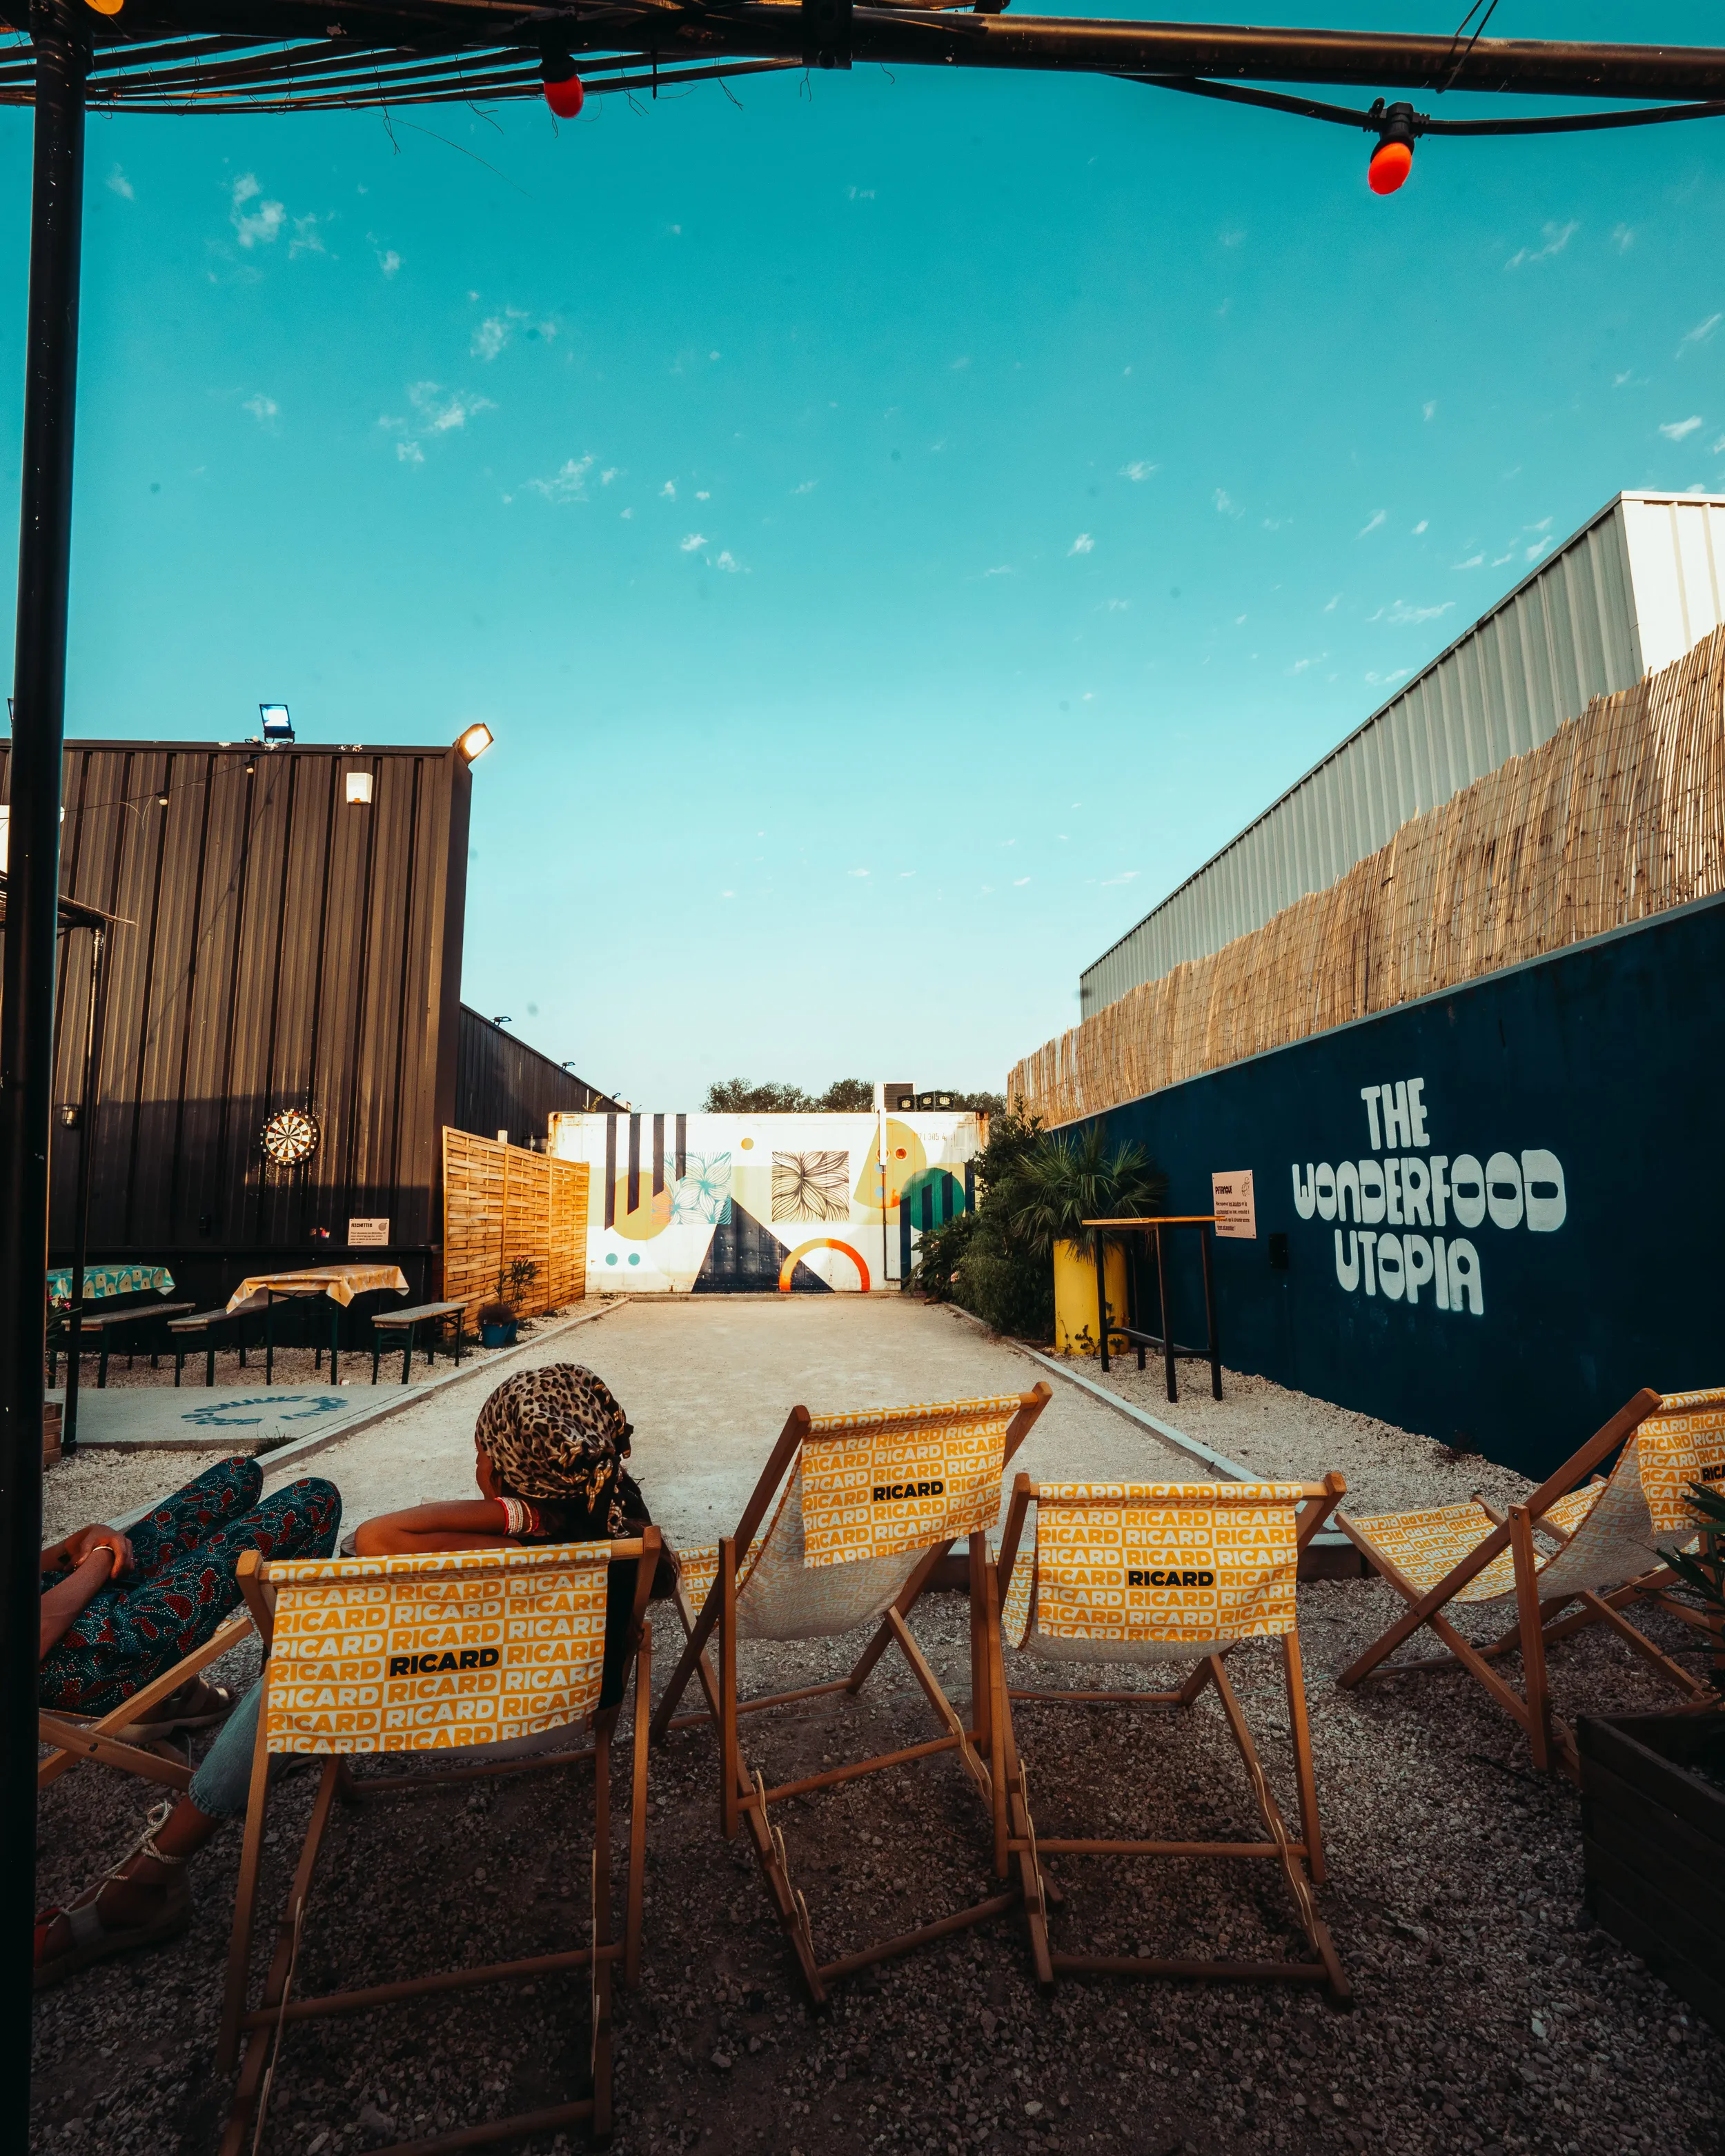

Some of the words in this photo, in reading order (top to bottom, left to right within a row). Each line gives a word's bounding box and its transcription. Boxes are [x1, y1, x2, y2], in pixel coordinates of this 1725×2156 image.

[1361, 1078, 1430, 1150] THE
[1292, 1149, 1566, 1232] WONDERFOOD
[1334, 1229, 1483, 1315] UTOPIA
[811, 1414, 883, 1432] RICARD
[888, 1407, 956, 1424] RICARD
[959, 1399, 1021, 1415] RICARD
[1657, 1395, 1704, 1411] ICARD
[802, 1437, 871, 1458] RICARD
[876, 1428, 941, 1448] RICARD
[946, 1421, 1008, 1439] RICARD
[1637, 1418, 1688, 1436] RICARD
[1638, 1434, 1691, 1452] RICARD
[802, 1452, 869, 1474] RICARD
[874, 1444, 941, 1465] RICARD
[946, 1436, 1005, 1456] RICARD
[802, 1471, 868, 1493] RICARD
[874, 1463, 943, 1483] RICARD
[947, 1453, 1004, 1475] RICARD
[1639, 1452, 1697, 1469] RICARD
[802, 1490, 868, 1514] RICARD
[874, 1481, 943, 1501] RICARD
[949, 1468, 1000, 1493] RICARD
[803, 1508, 868, 1531] RICARD
[874, 1500, 945, 1521] RICARD
[949, 1485, 1000, 1511] RICARD
[1039, 1485, 1123, 1500] RICARD
[1129, 1485, 1214, 1499] RICARD
[1221, 1485, 1303, 1500] RICARD
[805, 1527, 869, 1552] RICARD
[875, 1519, 943, 1540] RICARD
[947, 1500, 1000, 1527] RICARD
[1038, 1510, 1118, 1525] RICARD
[1125, 1511, 1208, 1526] RICARD
[1215, 1510, 1295, 1526] RICARD
[1038, 1528, 1118, 1544] RICARD
[1126, 1530, 1210, 1545] RICARD
[1216, 1528, 1297, 1545] RICARD
[268, 1564, 382, 1583] RICARD
[391, 1557, 500, 1576] RICARD
[509, 1547, 611, 1567] RICARD
[805, 1547, 870, 1568] RICARD
[1038, 1548, 1120, 1565] RICARD
[1127, 1550, 1212, 1565] RICARD
[1217, 1548, 1298, 1566] RICARD
[277, 1587, 387, 1611] RICARD
[396, 1581, 502, 1601] RICARD
[510, 1572, 608, 1596] RICARD
[1038, 1569, 1122, 1585] RICARD
[1128, 1570, 1214, 1586] RICARD
[1220, 1567, 1297, 1586] RICARD
[275, 1608, 386, 1634] RICARD
[394, 1601, 501, 1624] RICARD
[509, 1593, 607, 1614] RICARD
[1038, 1587, 1123, 1606] RICARD
[1129, 1591, 1214, 1607] RICARD
[1221, 1584, 1297, 1606] RICARD
[1038, 1605, 1123, 1623] RICARD
[1130, 1611, 1214, 1625] RICARD
[1220, 1601, 1295, 1624] RICARD
[271, 1633, 384, 1660] RICARD
[392, 1623, 500, 1651] RICARD
[508, 1616, 606, 1640] RICARD
[1038, 1623, 1121, 1639] RICARD
[1128, 1628, 1212, 1641] RICARD
[1219, 1619, 1295, 1639] RICARD
[270, 1660, 382, 1684] RICARD
[389, 1648, 499, 1677] RICARD
[507, 1639, 604, 1665] RICARD
[268, 1686, 379, 1709] RICARD
[387, 1673, 497, 1703] RICARD
[504, 1662, 602, 1690] RICARD
[267, 1712, 377, 1732] RICARD
[385, 1699, 495, 1729] RICARD
[502, 1682, 600, 1717] RICARD
[267, 1737, 375, 1754] RICARD
[384, 1726, 493, 1751] RICARD
